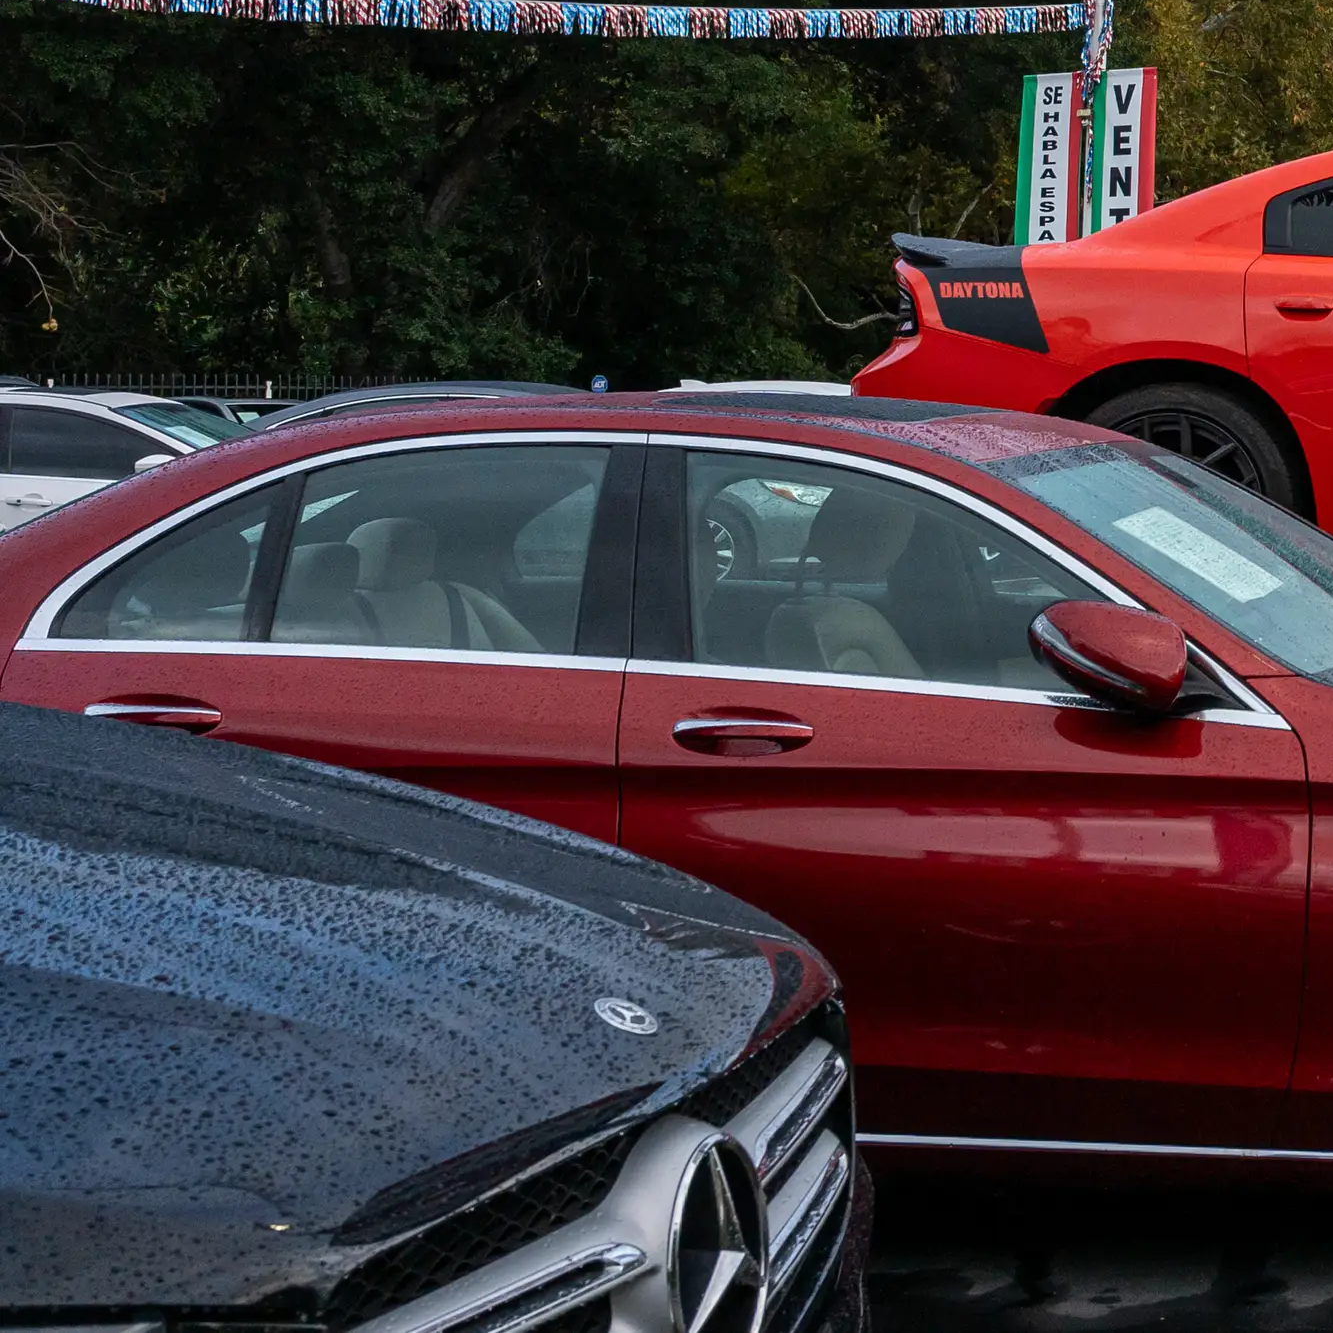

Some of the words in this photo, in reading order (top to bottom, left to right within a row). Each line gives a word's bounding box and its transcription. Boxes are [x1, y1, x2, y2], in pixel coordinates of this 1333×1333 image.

[1042, 85, 1064, 105] SE
[1039, 111, 1060, 180] HABLA
[939, 281, 1024, 299] DAYTONA
